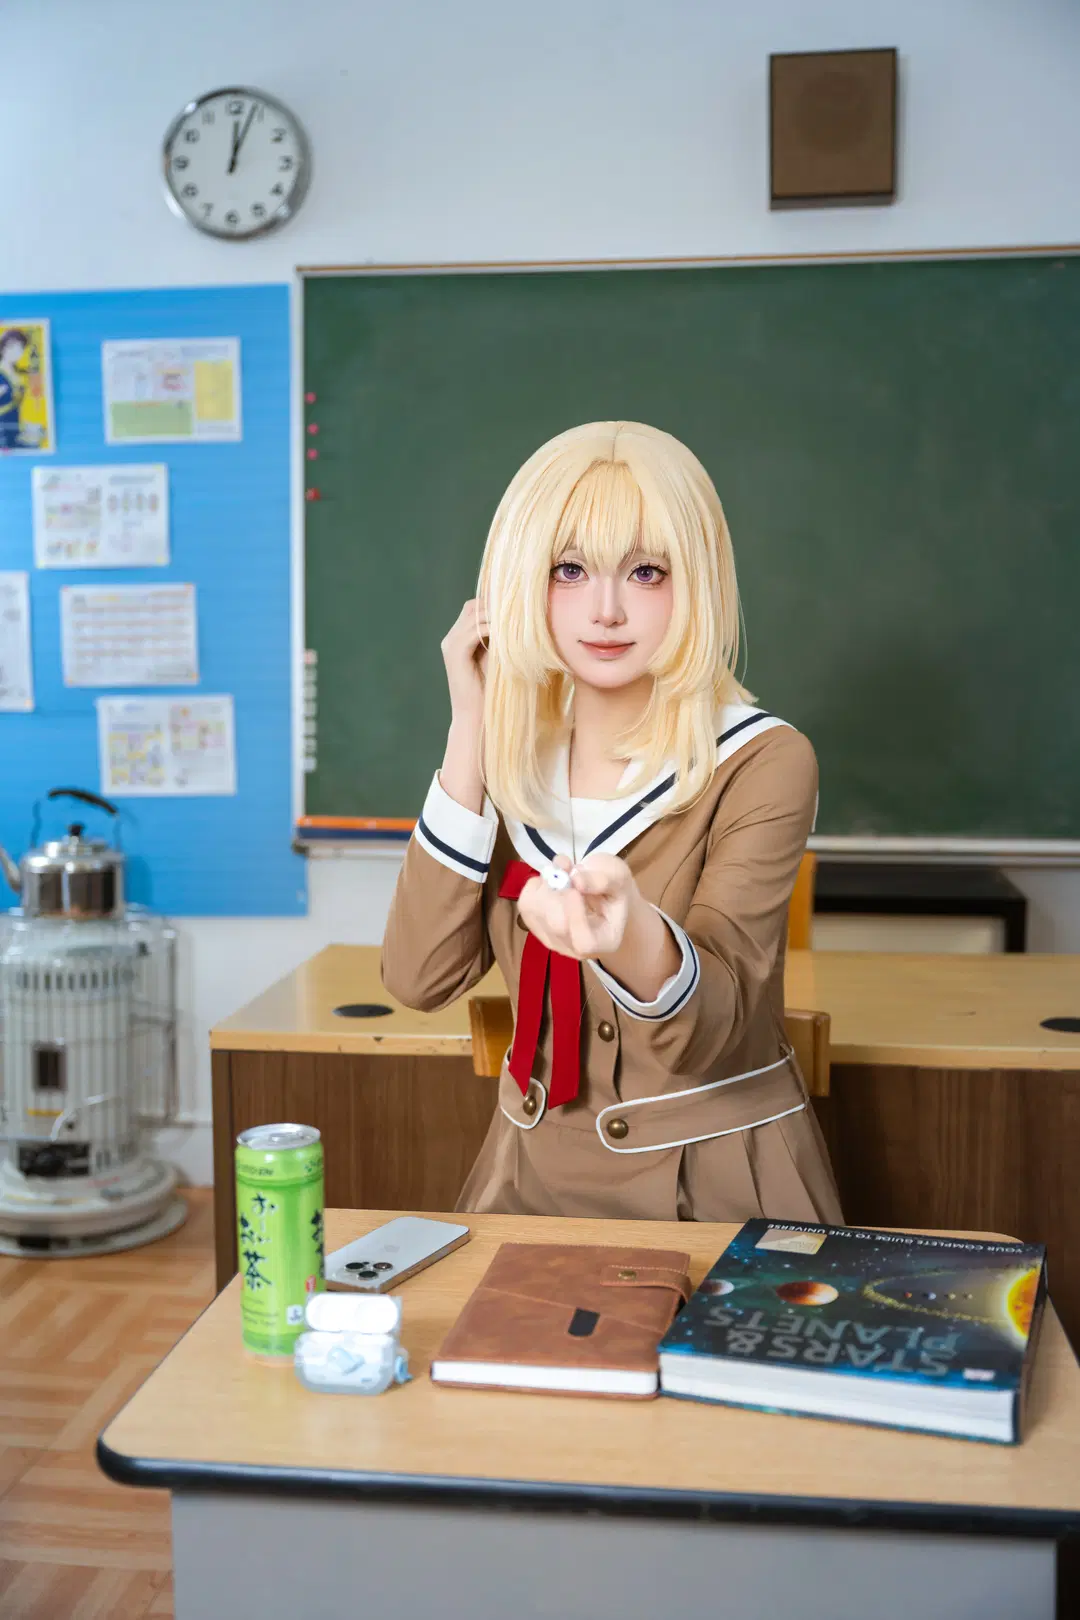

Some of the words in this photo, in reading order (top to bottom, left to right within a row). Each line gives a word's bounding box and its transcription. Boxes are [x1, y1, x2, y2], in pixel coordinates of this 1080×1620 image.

[271, 128, 286, 143] 2
[279, 155, 292, 171] 3
[270, 182, 283, 196] 4
[202, 202, 213, 217] 7
[767, 1223, 826, 1234] UNIVERSE
[829, 1229, 852, 1238] THE
[855, 1231, 873, 1240] TO
[876, 1234, 913, 1244] GUIDE
[917, 1239, 984, 1251] COMPLETE
[987, 1245, 1023, 1254] YOUR
[704, 1306, 962, 1352] PLANETS
[725, 1327, 765, 1354] &
[766, 1335, 956, 1376] STARS
